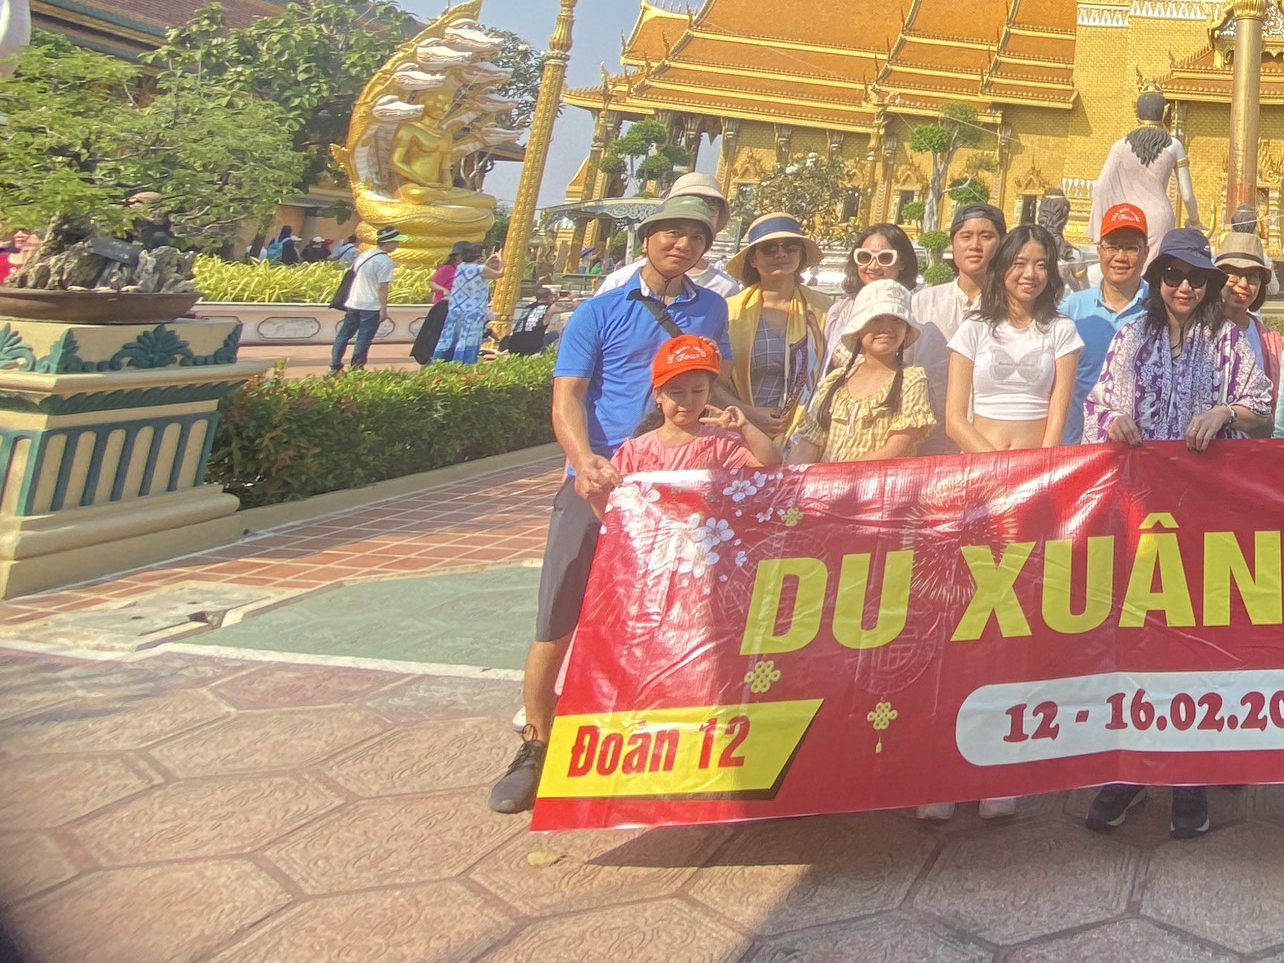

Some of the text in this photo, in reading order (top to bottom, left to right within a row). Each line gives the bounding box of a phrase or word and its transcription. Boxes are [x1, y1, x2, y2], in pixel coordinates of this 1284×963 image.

[740, 550, 915, 655] DU
[951, 512, 1283, 641] XUÂN
[697, 715, 751, 770] 12
[1004, 701, 1059, 742] 12
